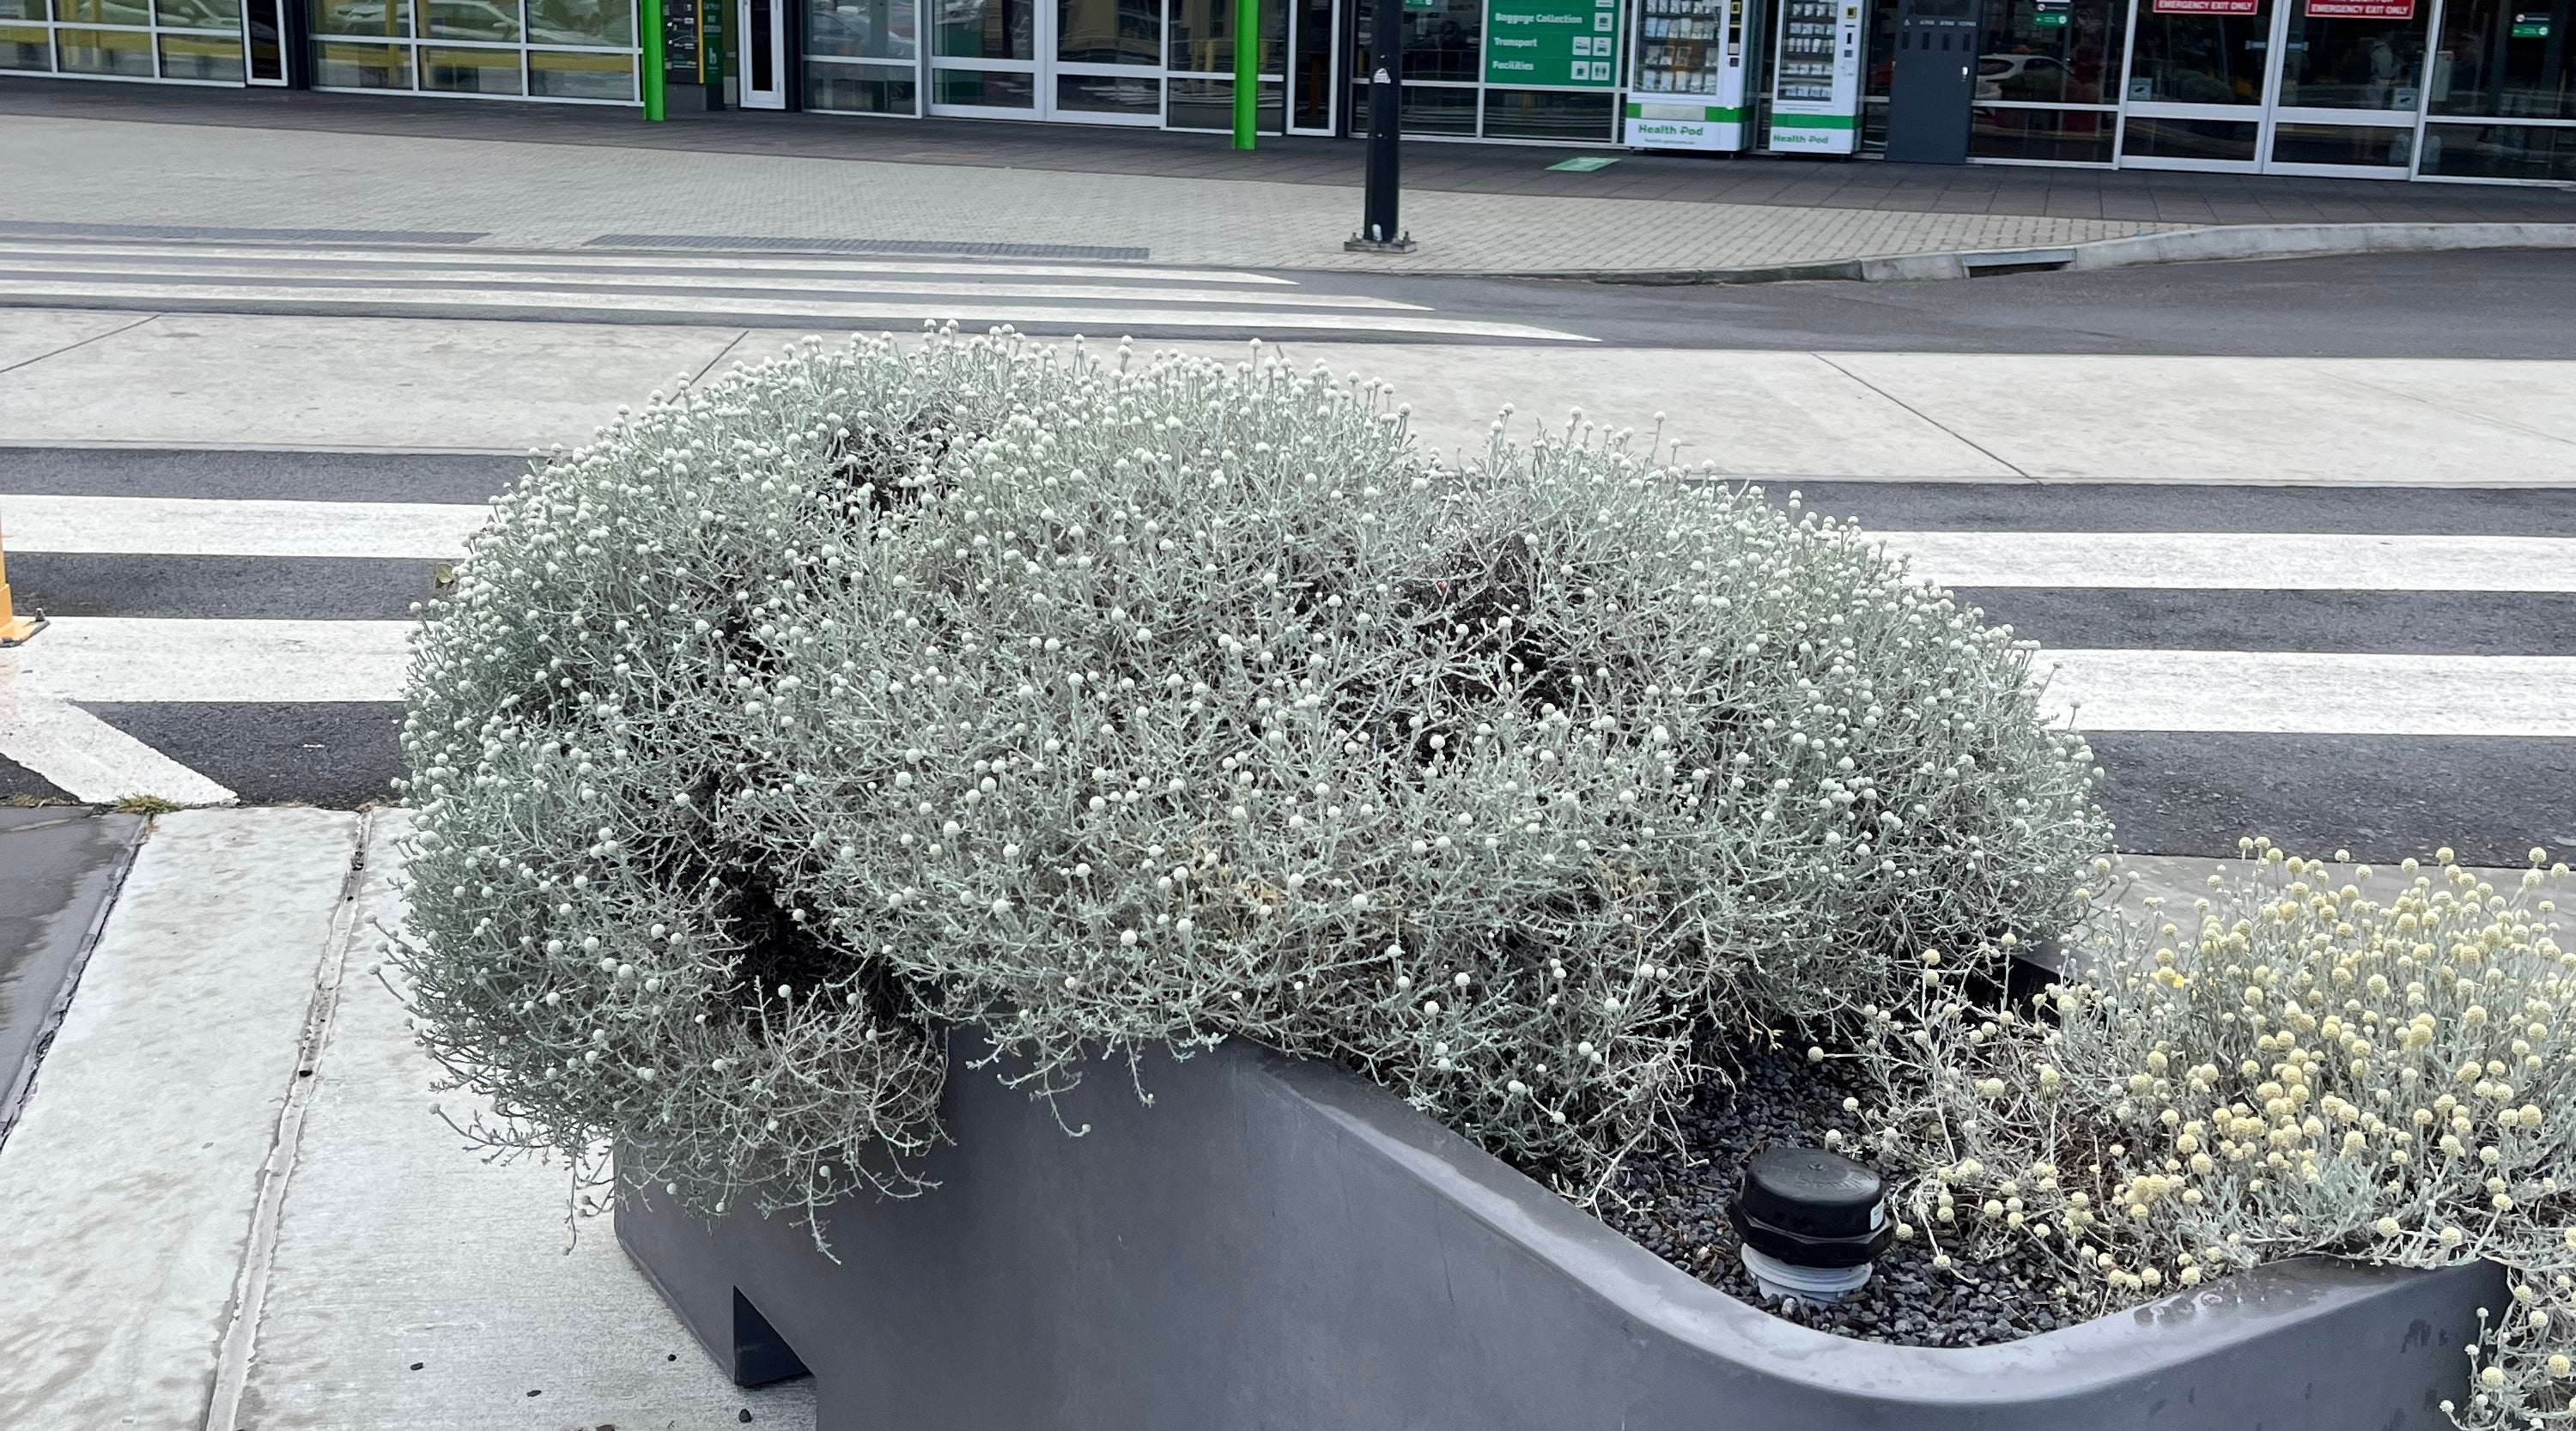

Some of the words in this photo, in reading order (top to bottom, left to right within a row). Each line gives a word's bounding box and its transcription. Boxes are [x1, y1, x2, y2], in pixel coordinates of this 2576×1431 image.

[1495, 12, 1534, 25] Baggage
[1536, 14, 1583, 24] Collection
[1494, 37, 1538, 49] Transport
[1492, 60, 1534, 70] Facilities
[1638, 124, 1677, 135] Health
[1680, 125, 1704, 136] Pod
[1773, 134, 1806, 143] Health
[1808, 135, 1829, 144] Pod
